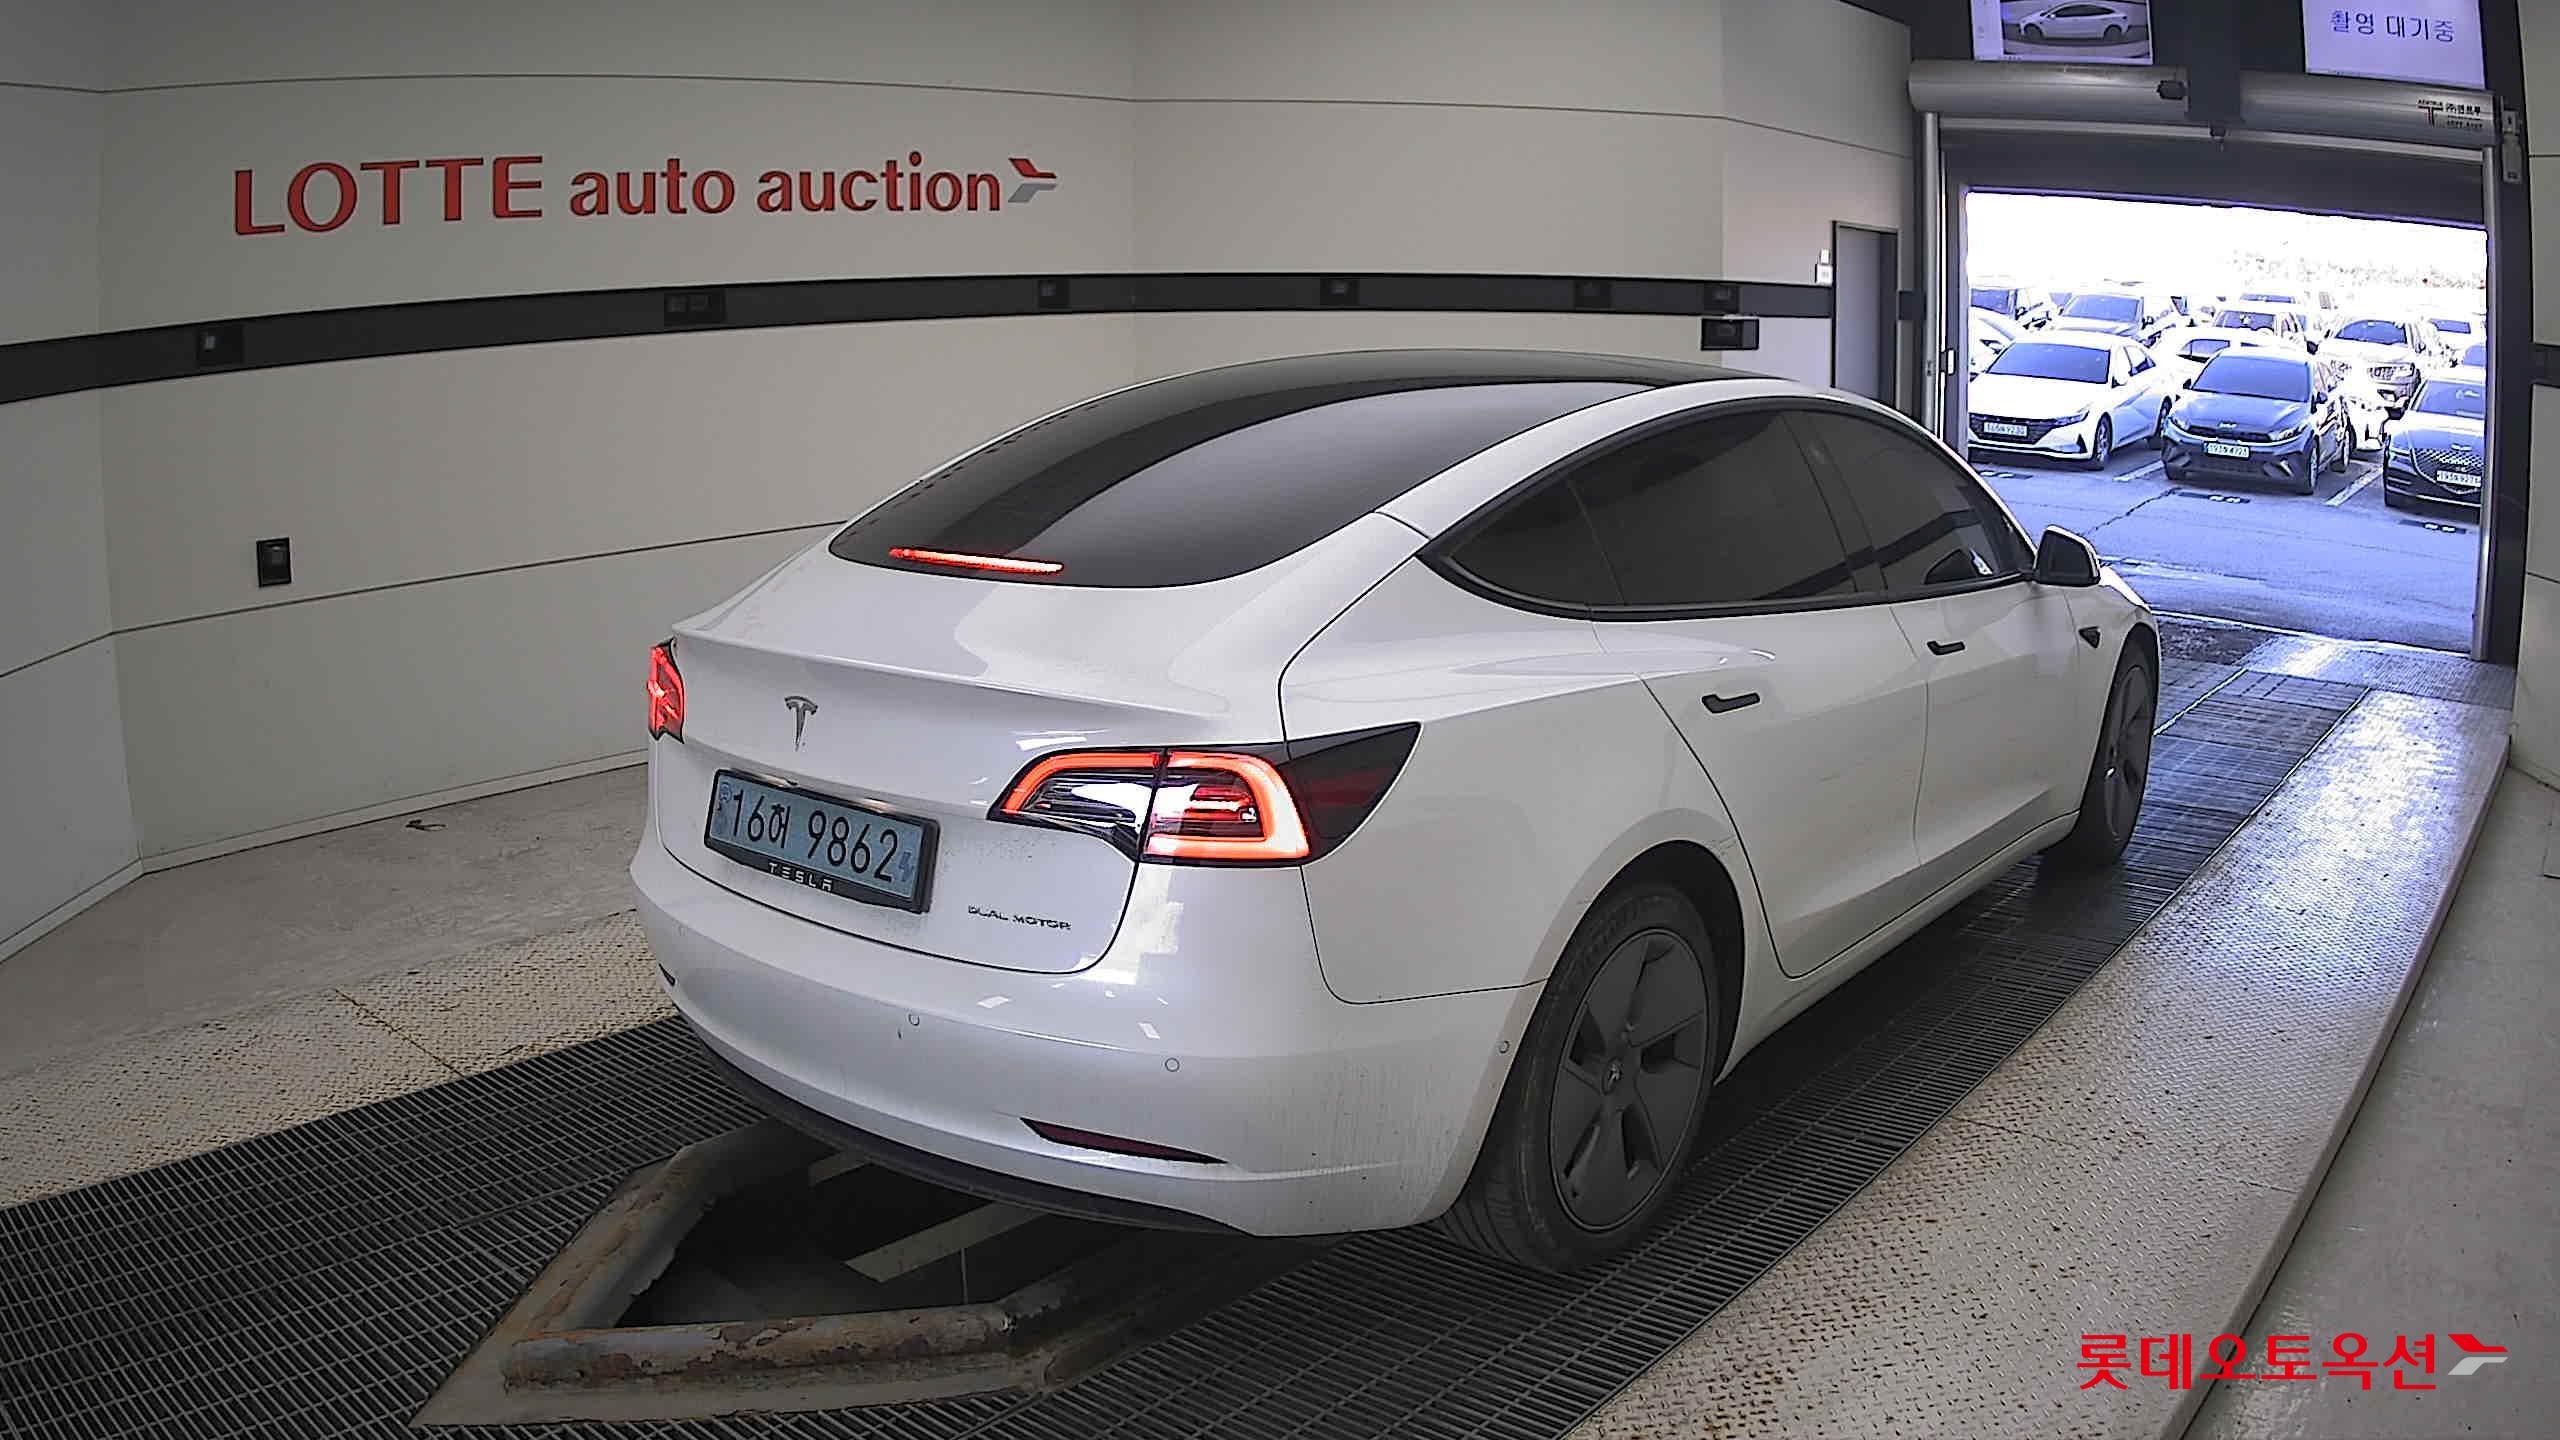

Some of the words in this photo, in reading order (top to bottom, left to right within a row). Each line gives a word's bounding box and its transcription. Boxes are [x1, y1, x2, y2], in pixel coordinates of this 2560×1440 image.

[2331, 10, 2375, 35] 촬영
[2386, 15, 2455, 43] 대기중
[235, 156, 542, 235] LOTTE
[570, 157, 736, 217] auto
[756, 152, 1002, 212] auction
[733, 789, 791, 849] 16허
[807, 809, 899, 883] 9862
[768, 862, 834, 891] TESLA
